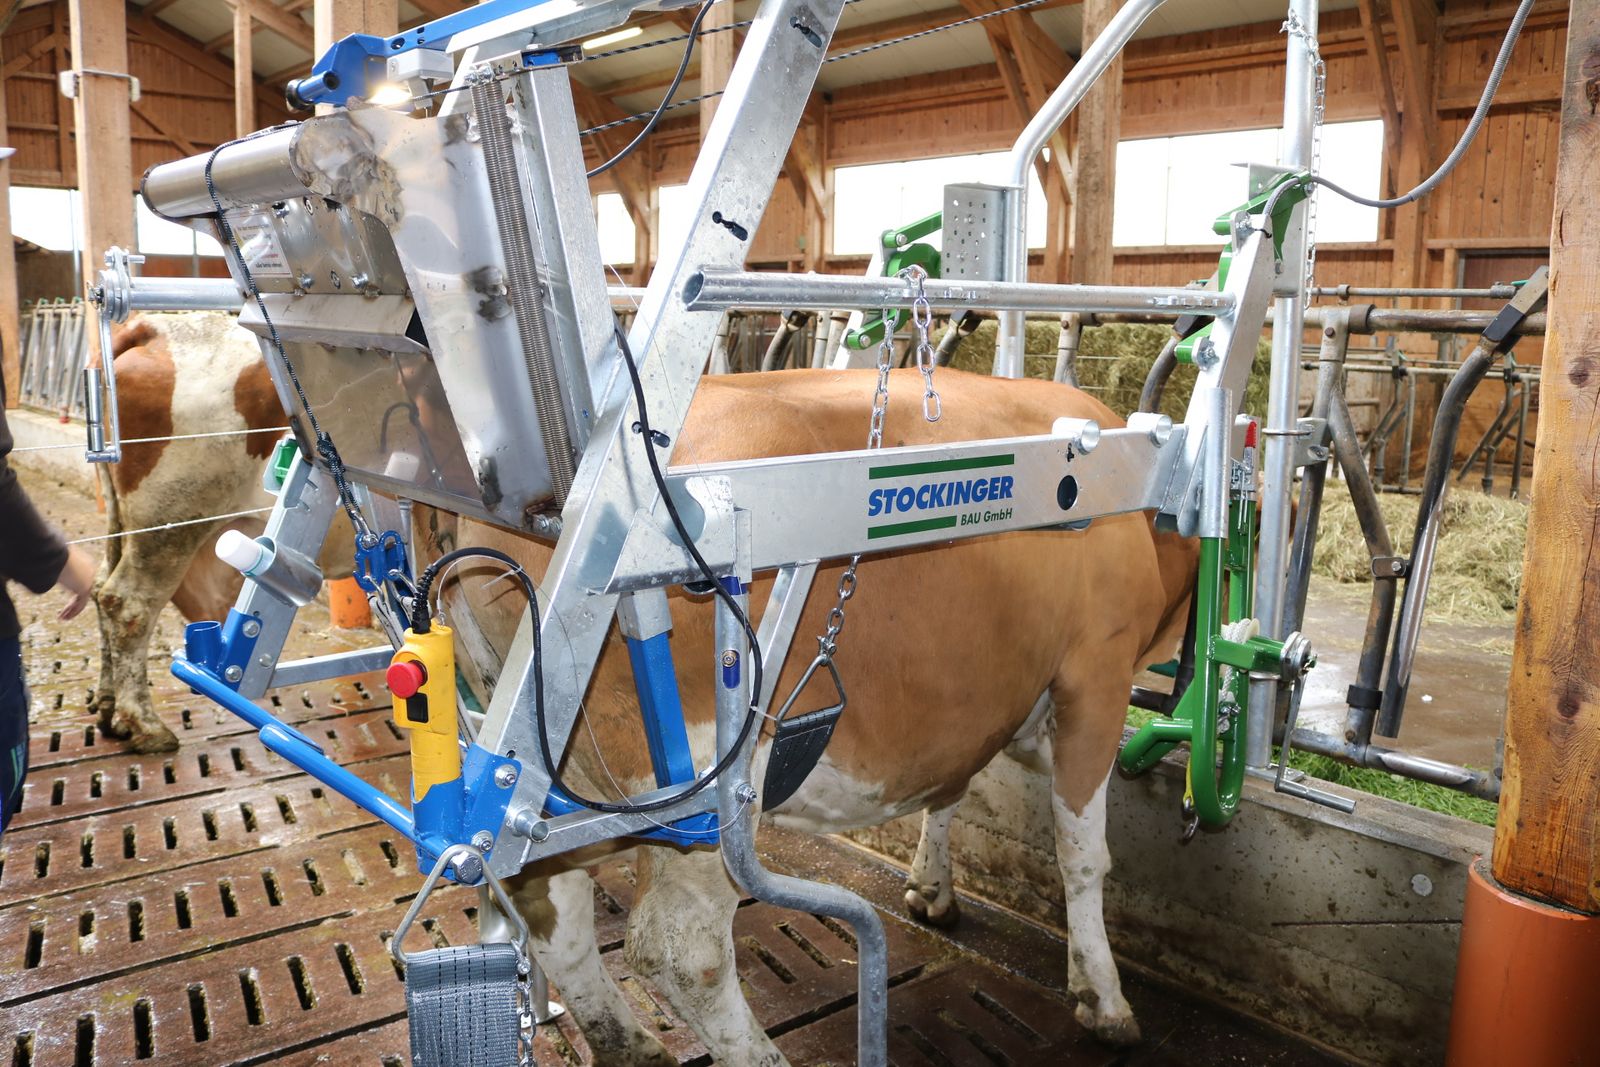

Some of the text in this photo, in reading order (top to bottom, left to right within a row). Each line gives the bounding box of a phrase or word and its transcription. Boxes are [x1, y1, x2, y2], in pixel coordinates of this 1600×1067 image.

[868, 475, 1014, 516] STOCKINGER
[961, 507, 1013, 526] BAU GmbH
